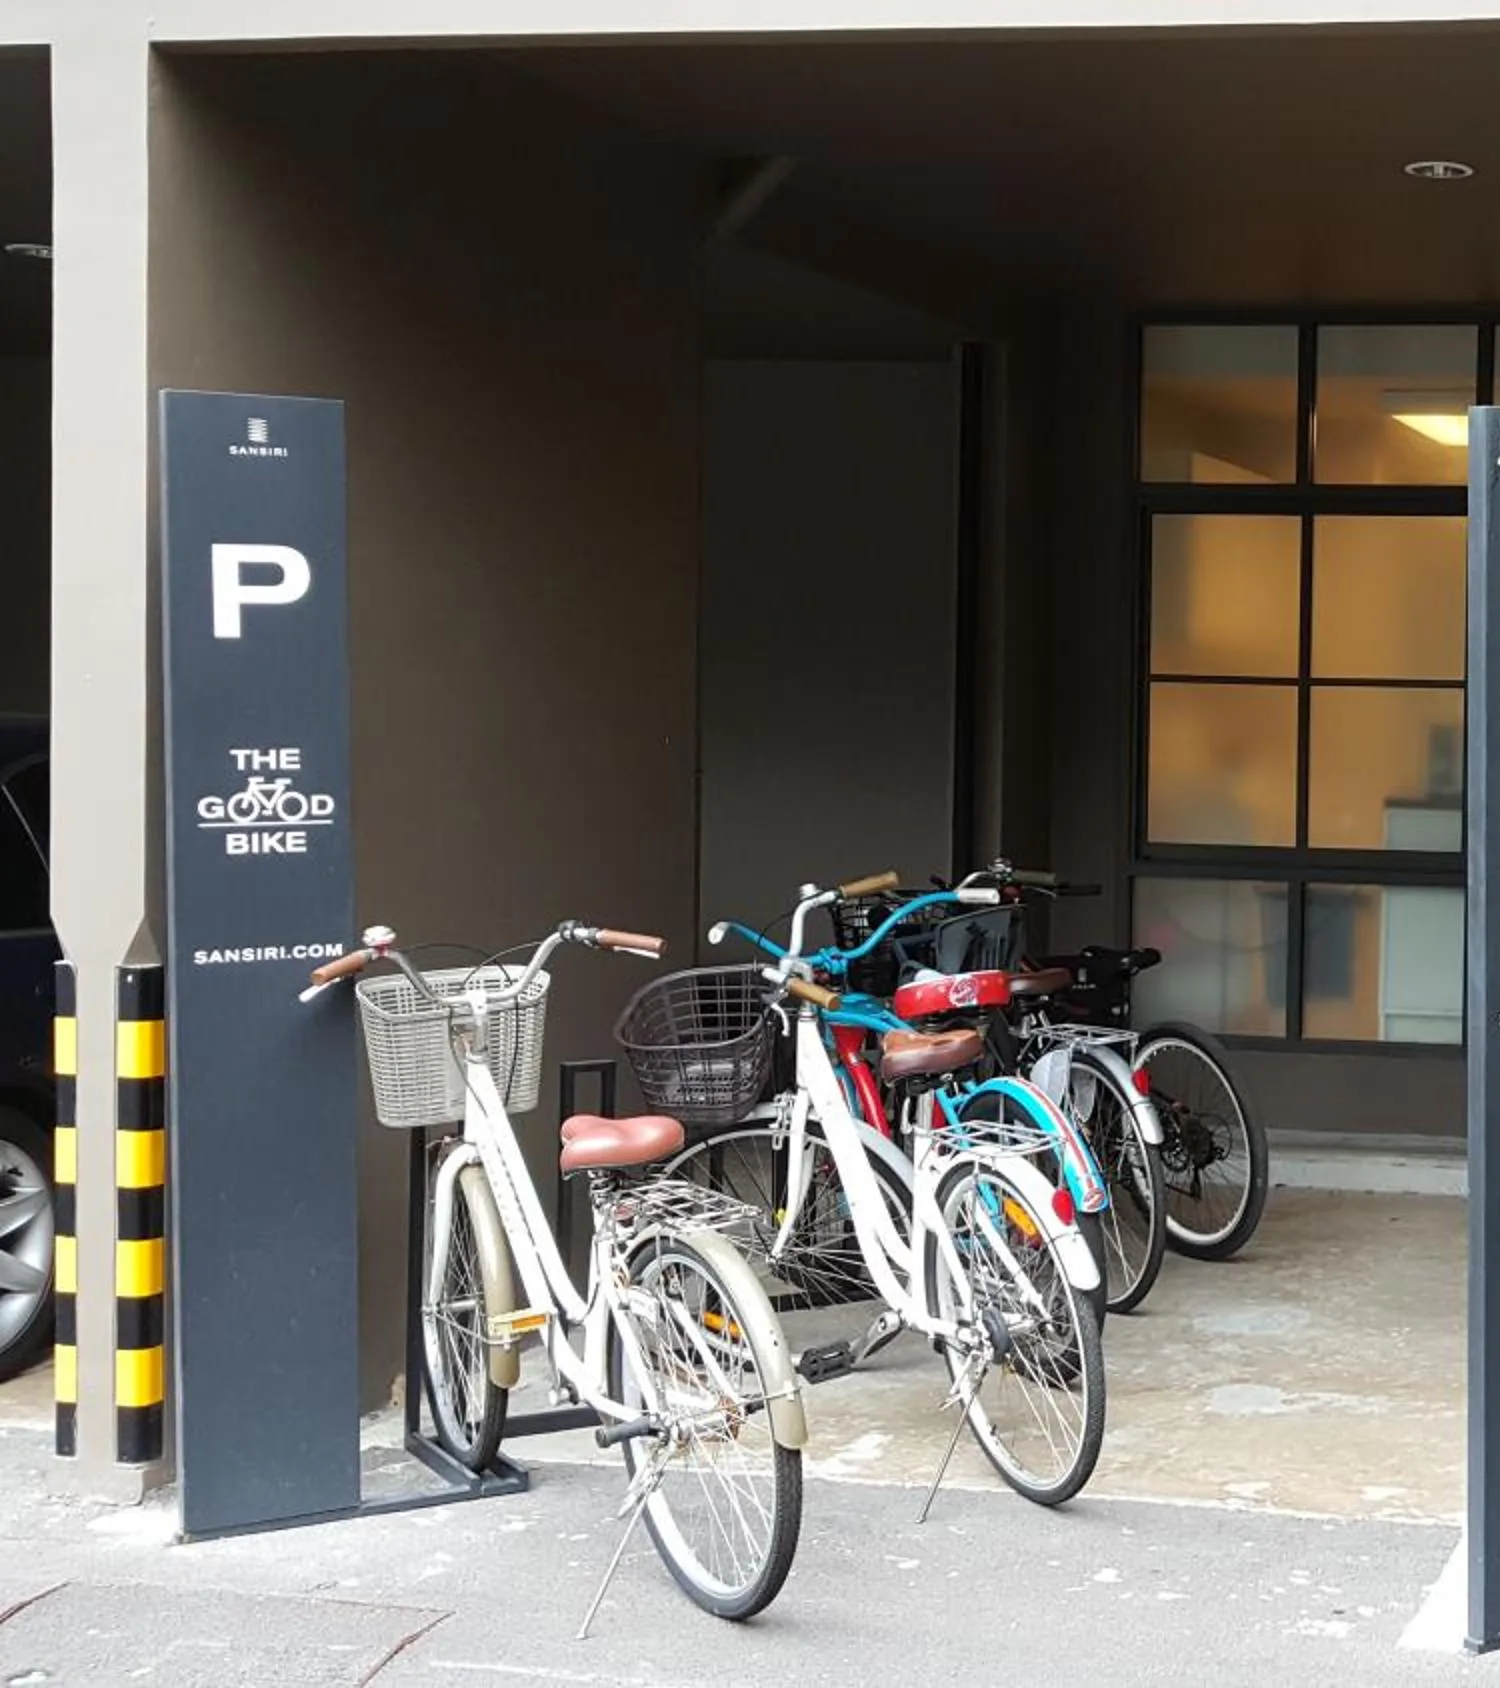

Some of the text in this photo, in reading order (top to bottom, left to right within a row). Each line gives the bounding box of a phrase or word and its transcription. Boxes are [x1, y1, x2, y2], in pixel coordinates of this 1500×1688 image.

[228, 444, 289, 458] SANSIRI
[211, 543, 311, 639] P
[229, 748, 302, 771] THE
[226, 831, 308, 855] BIKE
[194, 943, 344, 965] SANSIRI.COM
